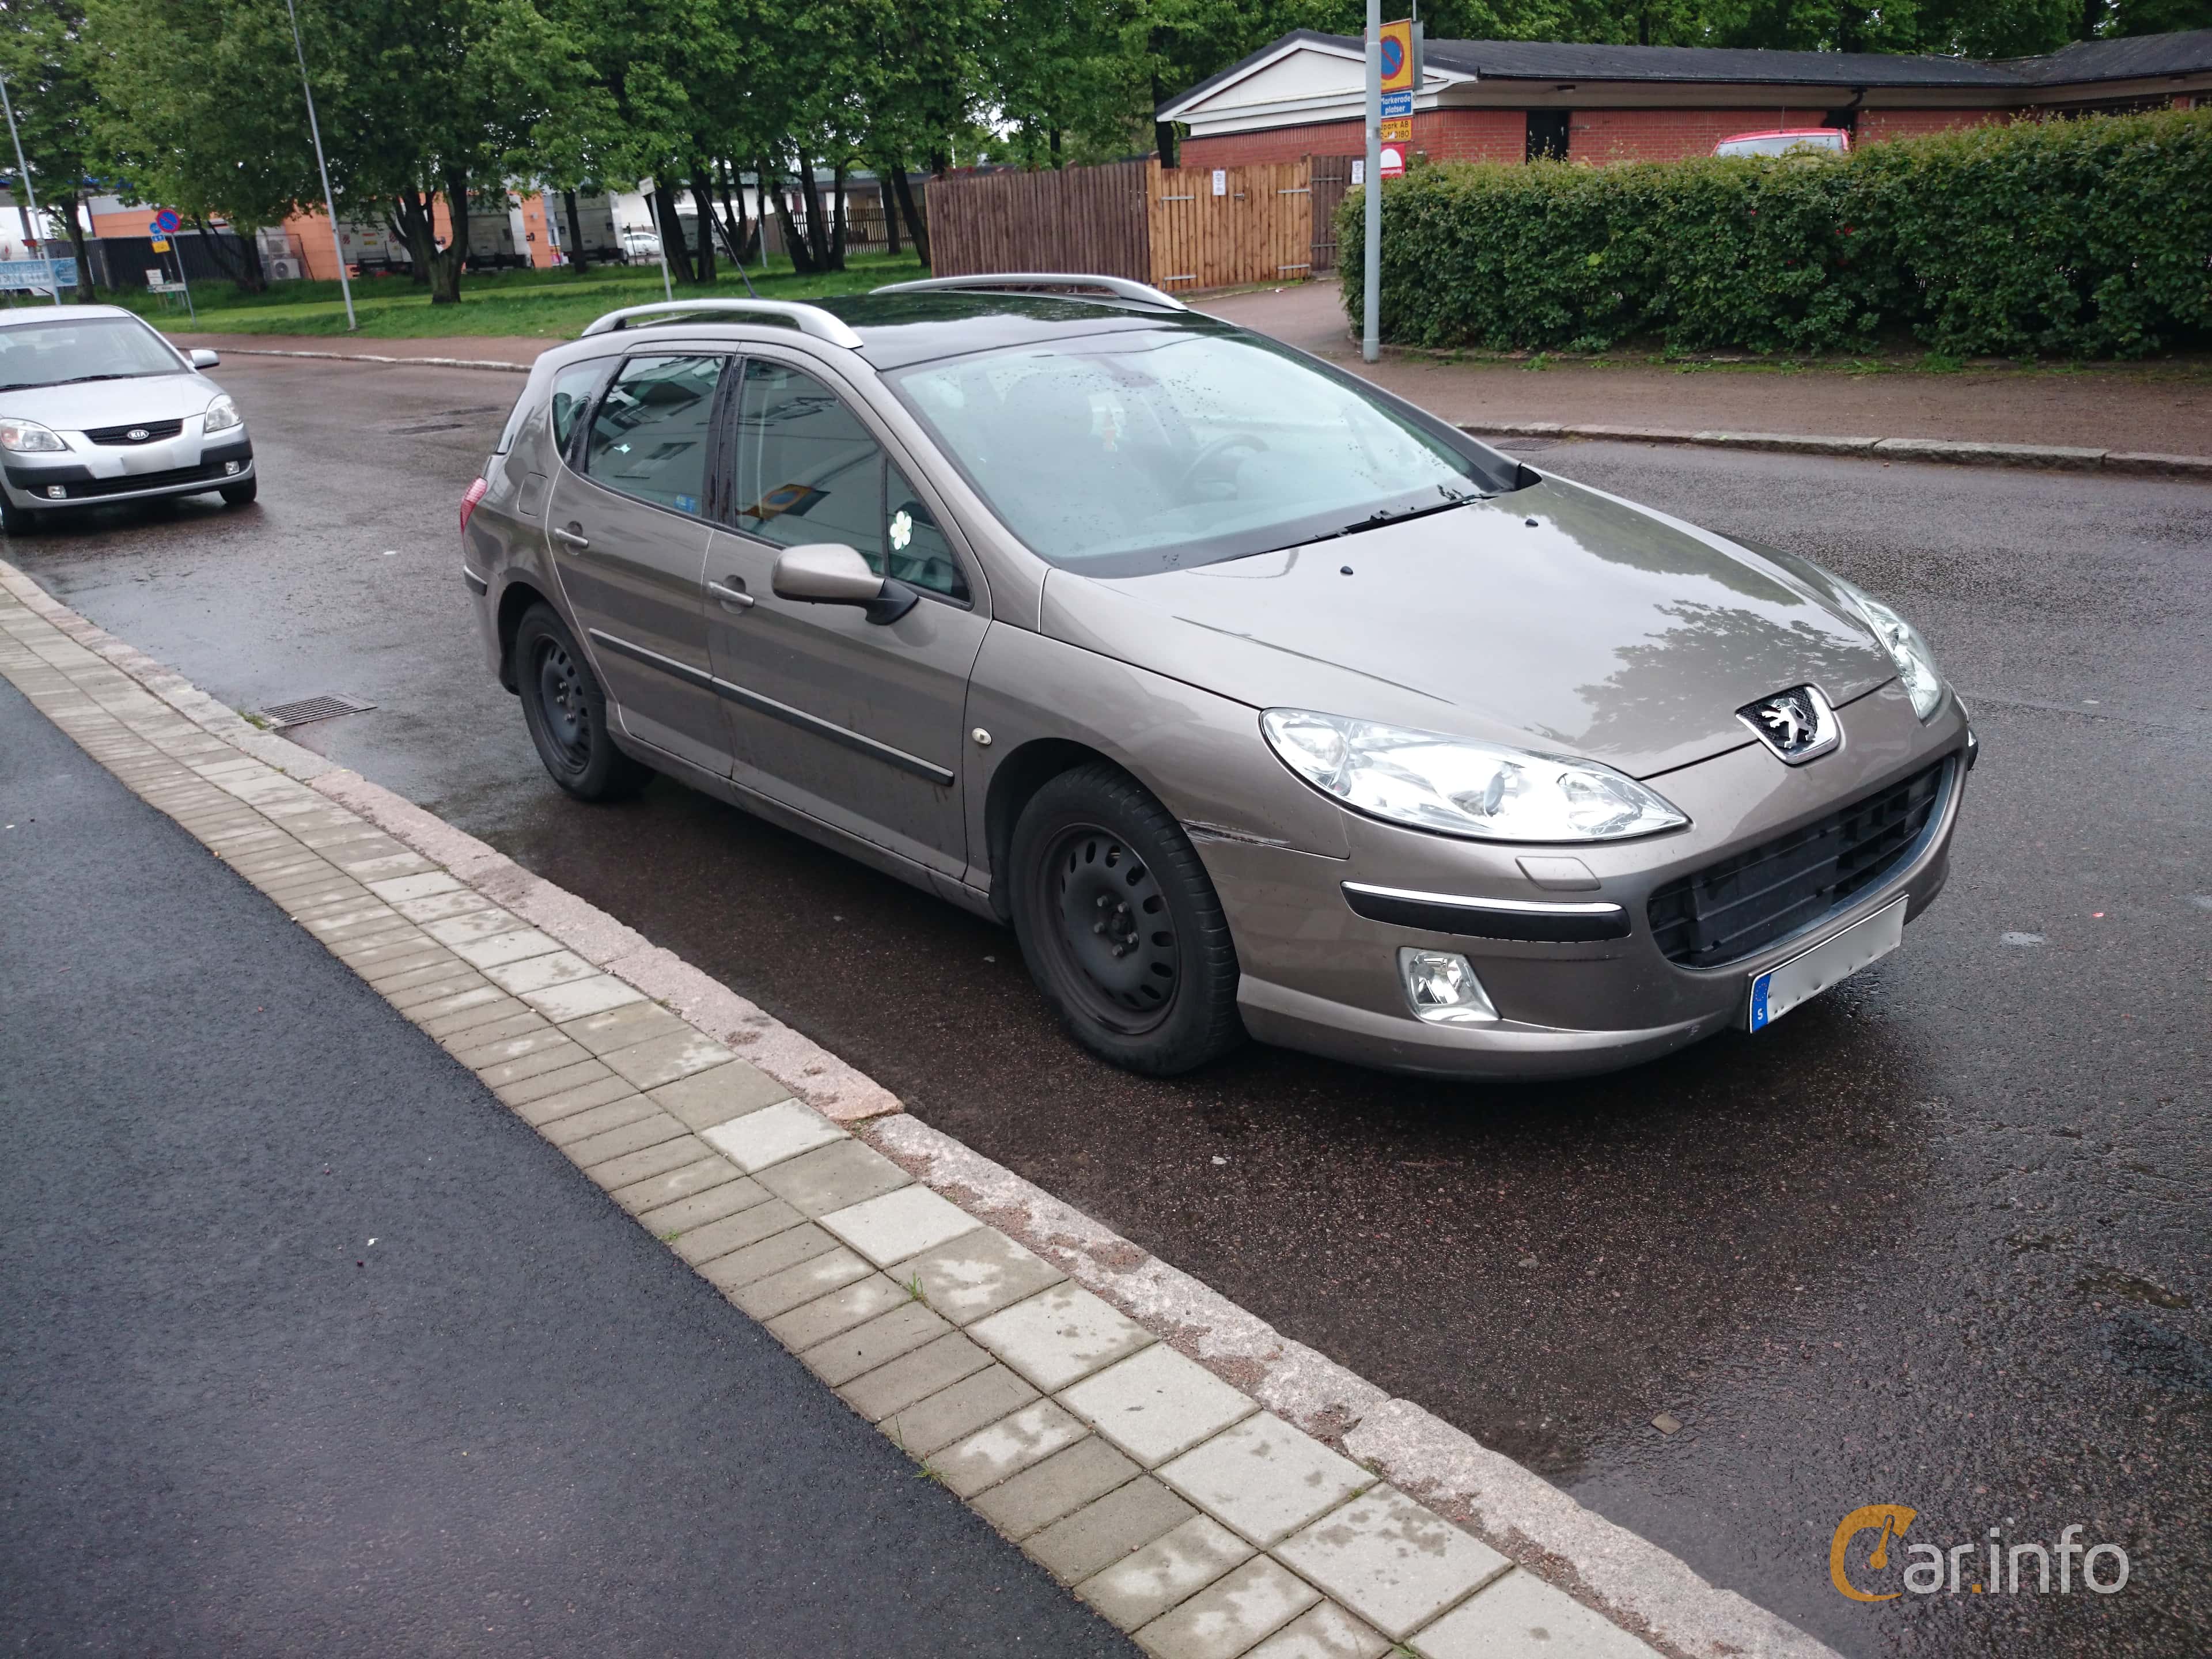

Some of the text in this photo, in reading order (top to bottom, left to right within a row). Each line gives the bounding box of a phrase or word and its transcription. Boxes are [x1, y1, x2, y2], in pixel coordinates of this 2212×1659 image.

[1385, 105, 1406, 115] platser
[1381, 122, 1398, 130] park
[1758, 1007, 1763, 1020] S
